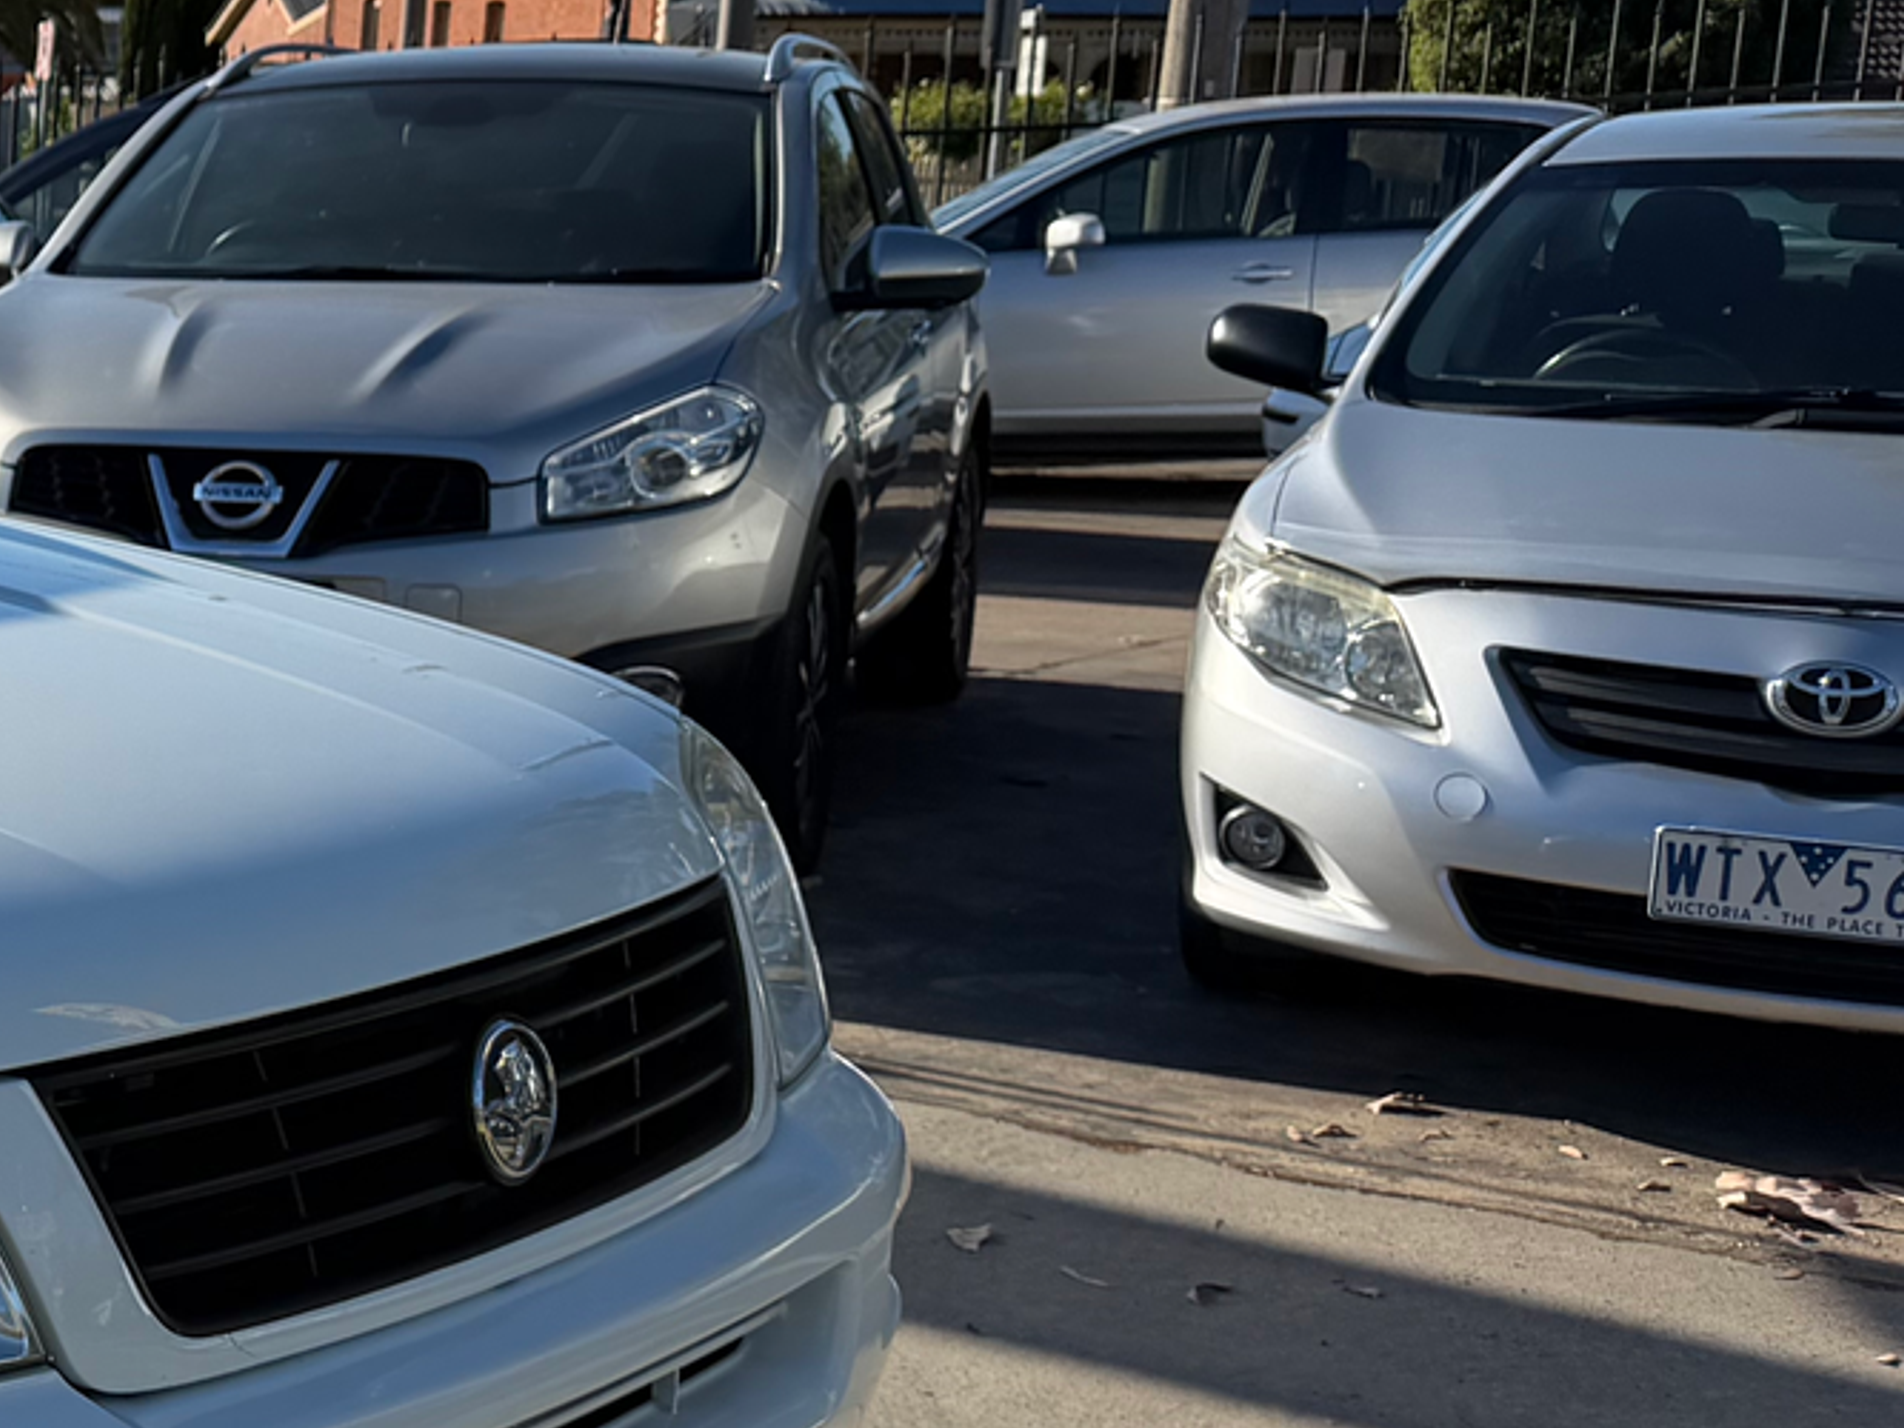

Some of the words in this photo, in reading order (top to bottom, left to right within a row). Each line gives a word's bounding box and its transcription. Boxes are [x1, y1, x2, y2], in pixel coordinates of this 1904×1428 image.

[201, 484, 272, 501] NISSAN
[1665, 840, 1789, 908] WTX
[1664, 899, 1752, 922] VICTORIA
[1781, 910, 1816, 930] THE
[1826, 917, 1885, 936] PLACE
